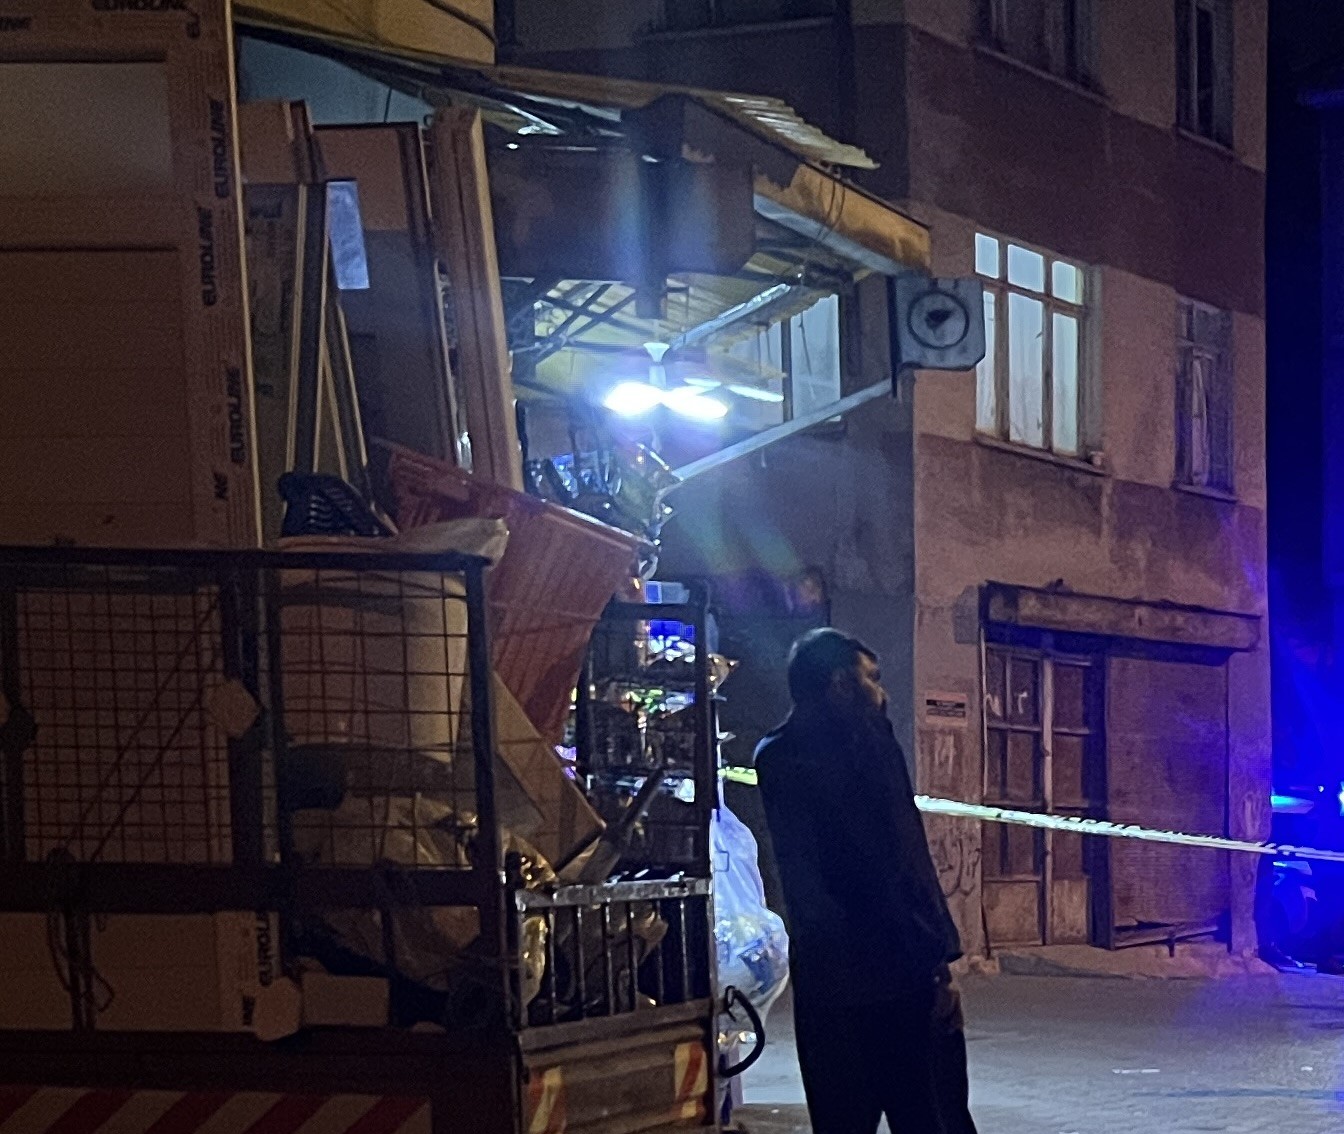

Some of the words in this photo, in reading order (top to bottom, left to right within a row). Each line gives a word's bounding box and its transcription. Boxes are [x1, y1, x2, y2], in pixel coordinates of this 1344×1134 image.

[209, 98, 230, 199] EUROLINE
[198, 206, 217, 306] EUROLINE
[226, 366, 246, 464] EUROLINE
